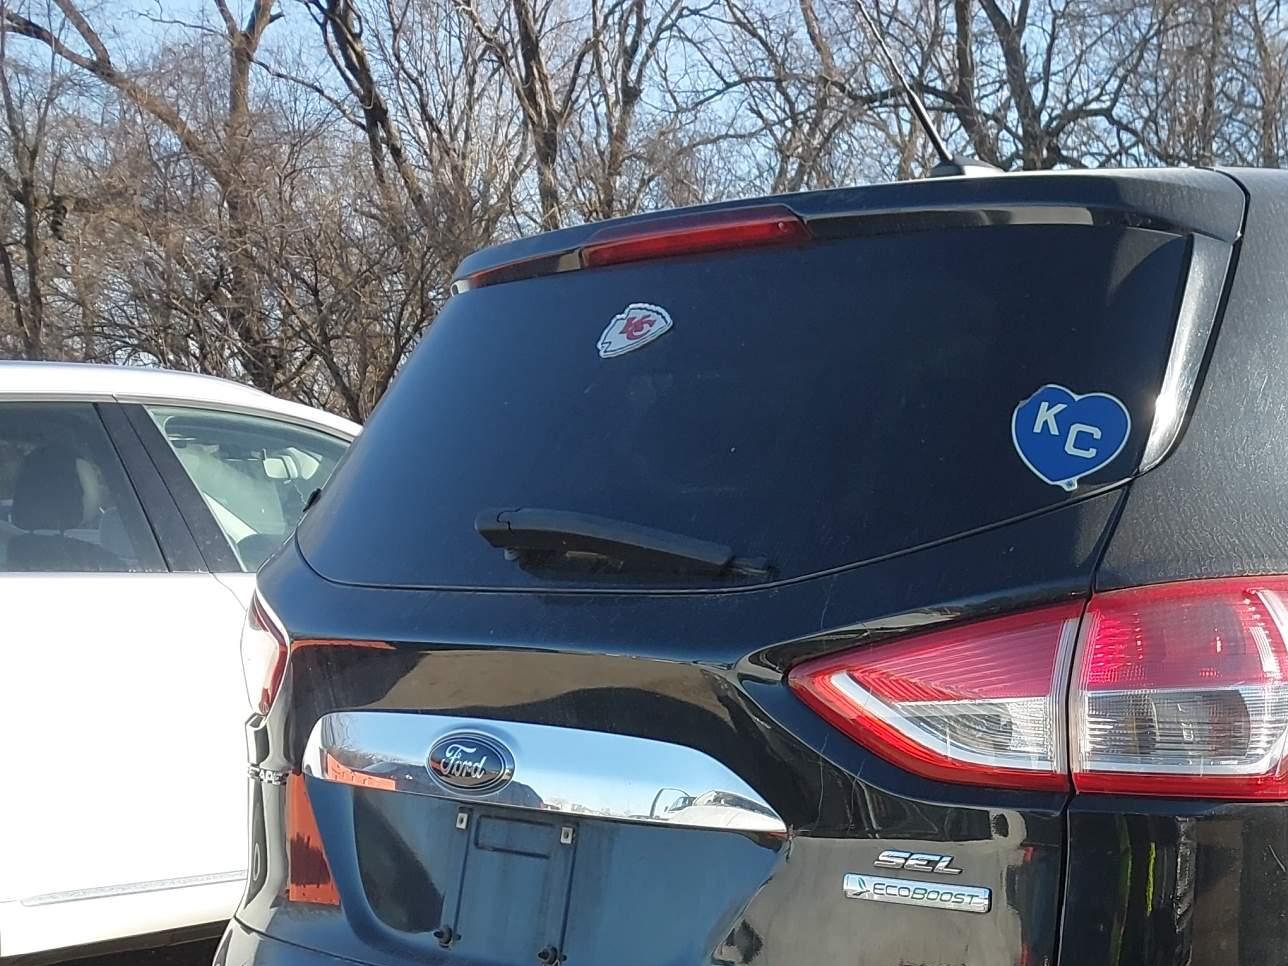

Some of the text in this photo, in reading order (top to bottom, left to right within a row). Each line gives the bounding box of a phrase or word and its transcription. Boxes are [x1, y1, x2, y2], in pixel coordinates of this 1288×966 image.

[619, 314, 657, 341] KC
[440, 743, 487, 779] Ford
[873, 849, 963, 875] SEL
[873, 882, 980, 905] ECOBOOST
